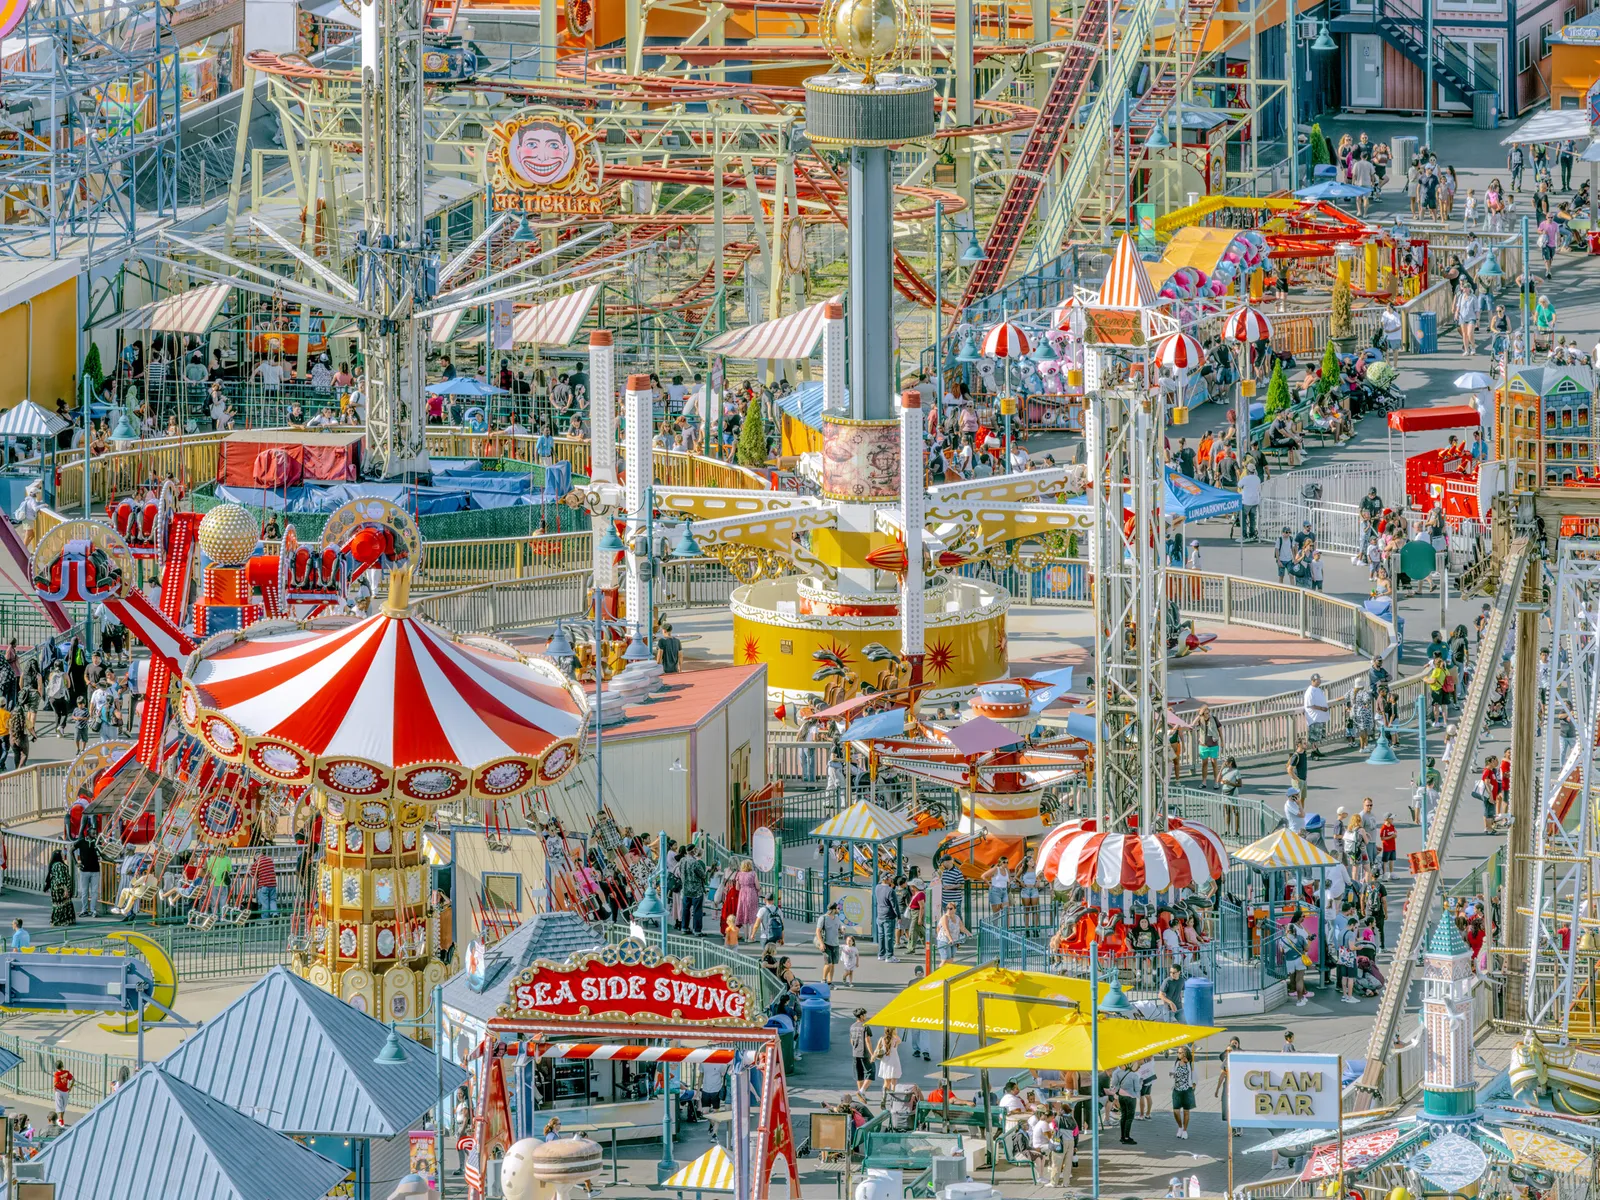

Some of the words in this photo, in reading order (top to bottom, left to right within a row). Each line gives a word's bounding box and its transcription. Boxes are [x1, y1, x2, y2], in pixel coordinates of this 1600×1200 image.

[523, 194, 603, 214] TICKLER
[1188, 499, 1240, 519] LUNAPARKNYC.COM
[797, 870, 803, 880] 6
[516, 981, 578, 1010] SEA
[581, 975, 647, 1001] SIDE
[652, 977, 746, 1017] SWING
[1243, 1069, 1323, 1093] CLAM
[1254, 1093, 1315, 1116] BAR
